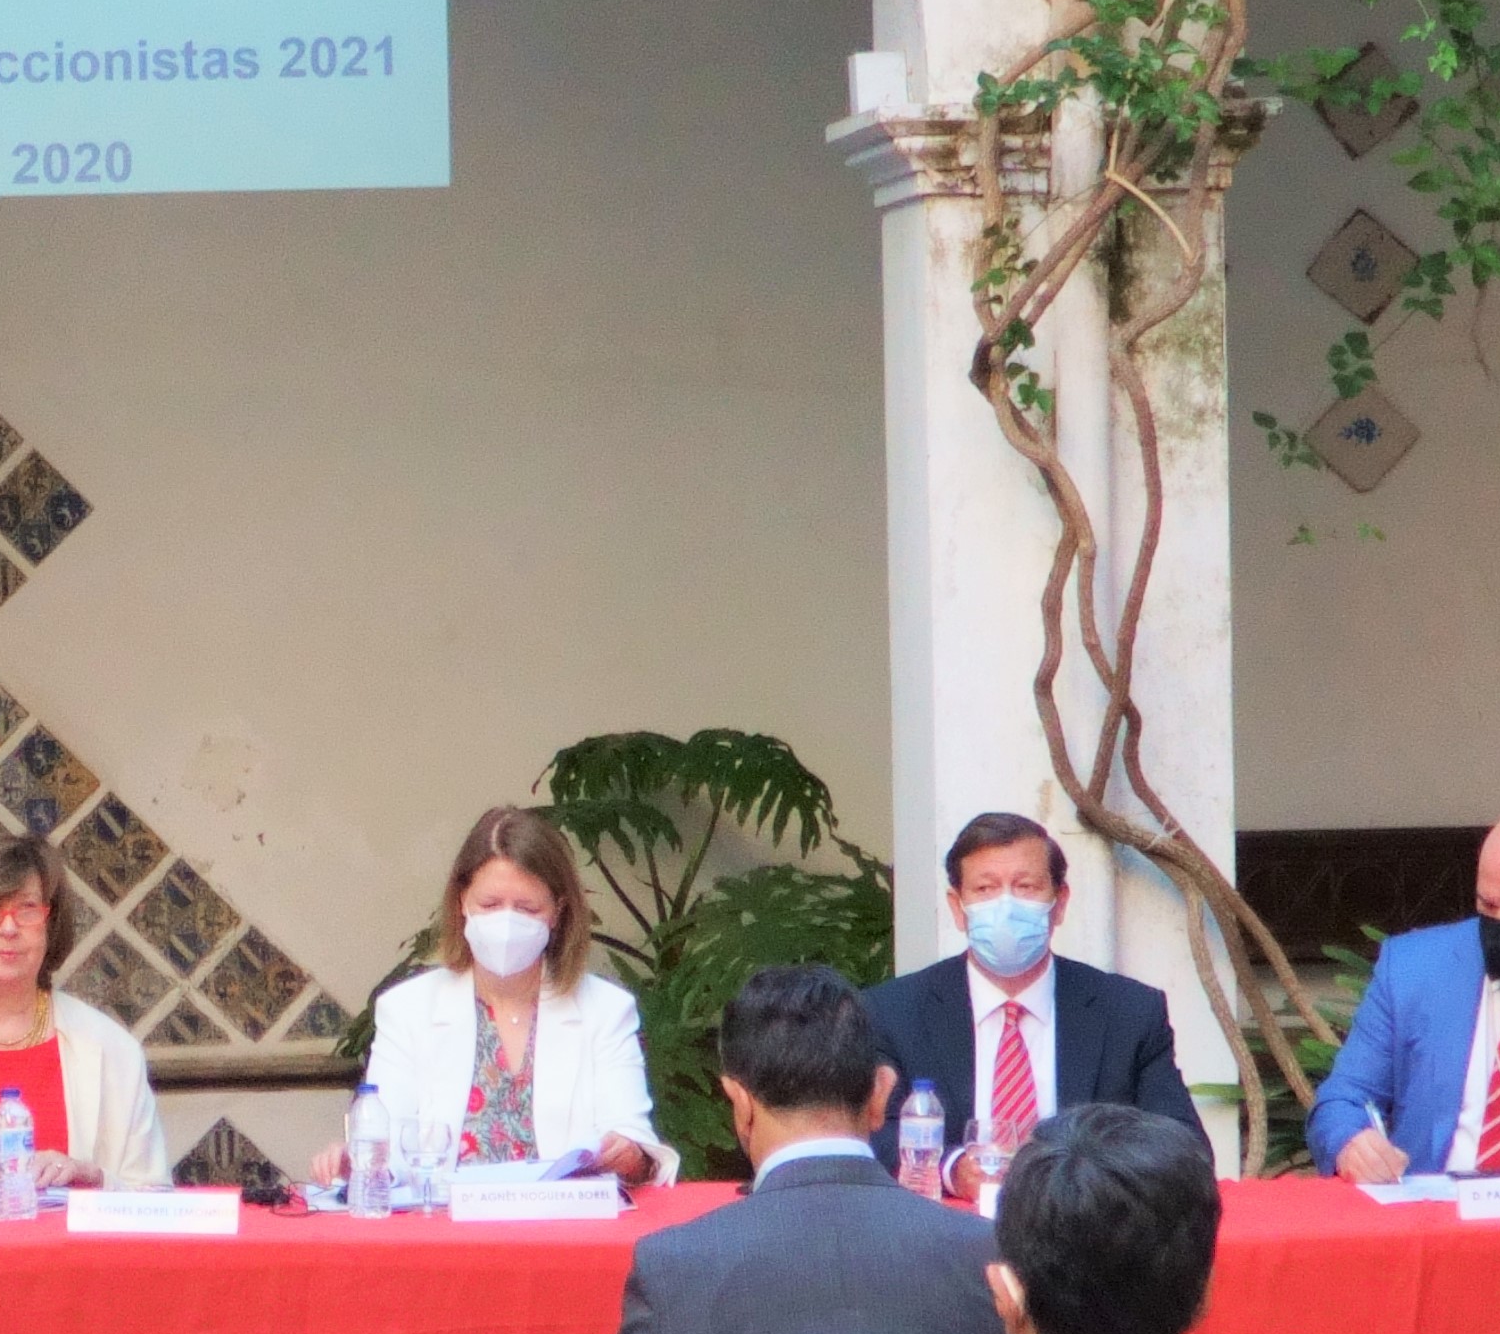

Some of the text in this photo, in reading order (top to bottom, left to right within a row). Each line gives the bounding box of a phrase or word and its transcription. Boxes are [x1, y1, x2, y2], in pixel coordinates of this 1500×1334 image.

[278, 34, 394, 79] 2021
[12, 141, 133, 185] 2020
[520, 1190, 576, 1202] NOGUERA
[578, 1188, 612, 1201] BOREL
